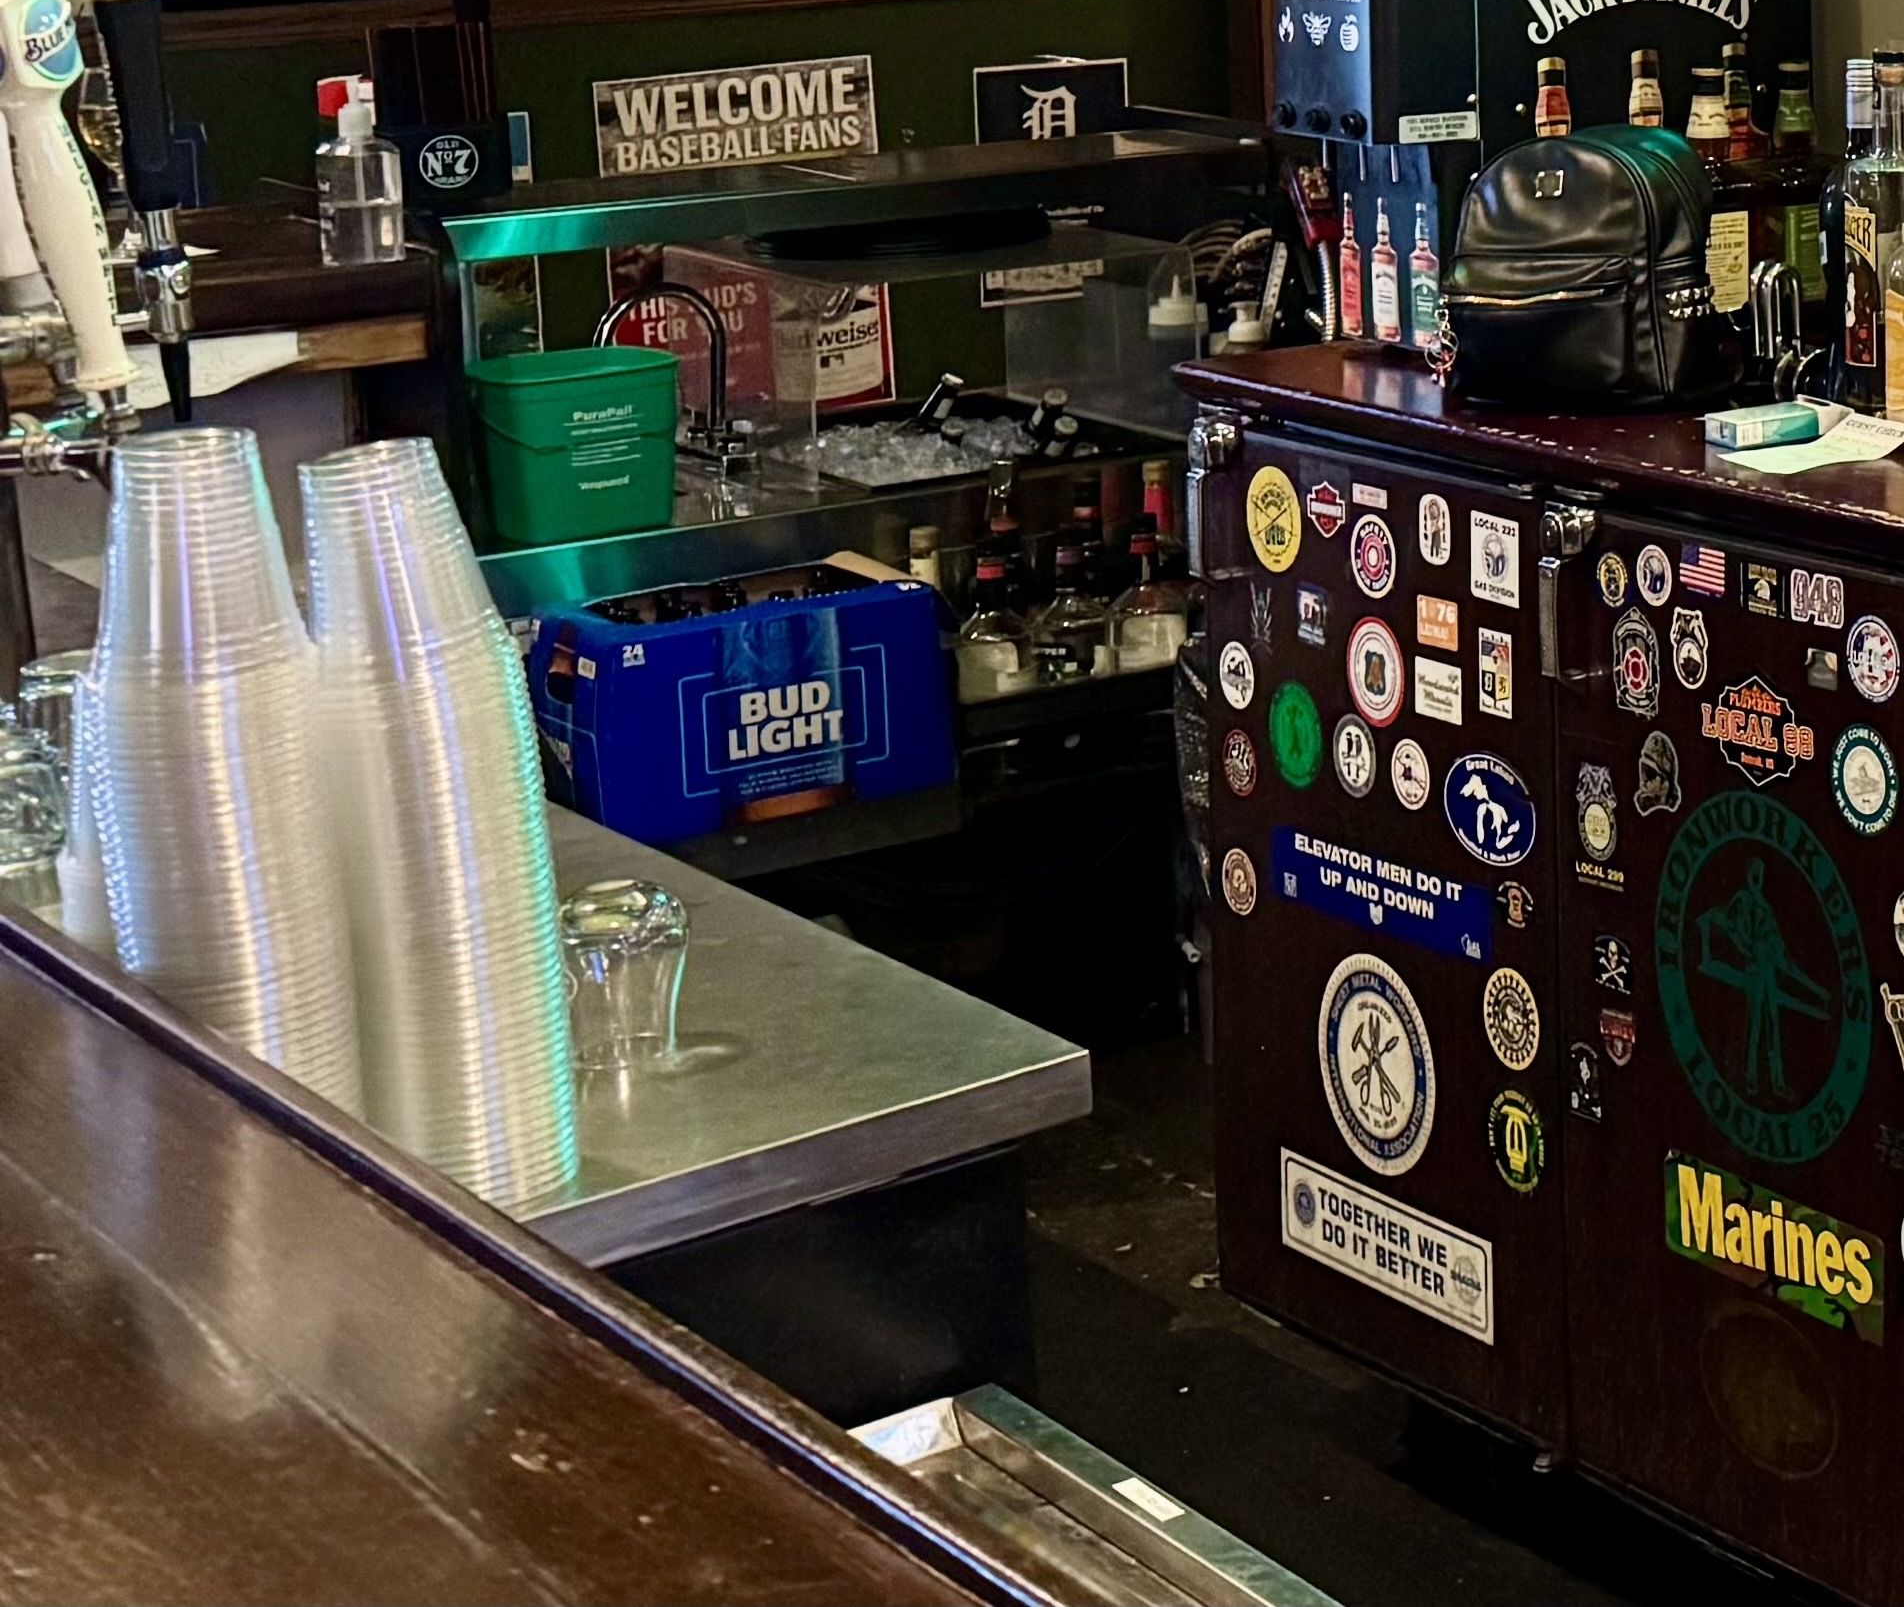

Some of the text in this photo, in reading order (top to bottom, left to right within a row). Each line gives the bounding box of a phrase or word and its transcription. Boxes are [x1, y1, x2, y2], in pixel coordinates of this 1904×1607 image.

[613, 65, 857, 136] WELCOME
[617, 114, 859, 172] BASEBALL FANS
[729, 710, 844, 761] LIGHT
[740, 681, 830, 724] BUD
[1295, 833, 1462, 901] ELEVATOR MEN DO IT
[1320, 867, 1433, 920] UP AND DOWN
[1318, 1188, 1447, 1268] TOGETHER WE
[1323, 1219, 1444, 1297] DO IT BETTER
[1677, 1164, 1875, 1307] Marines
